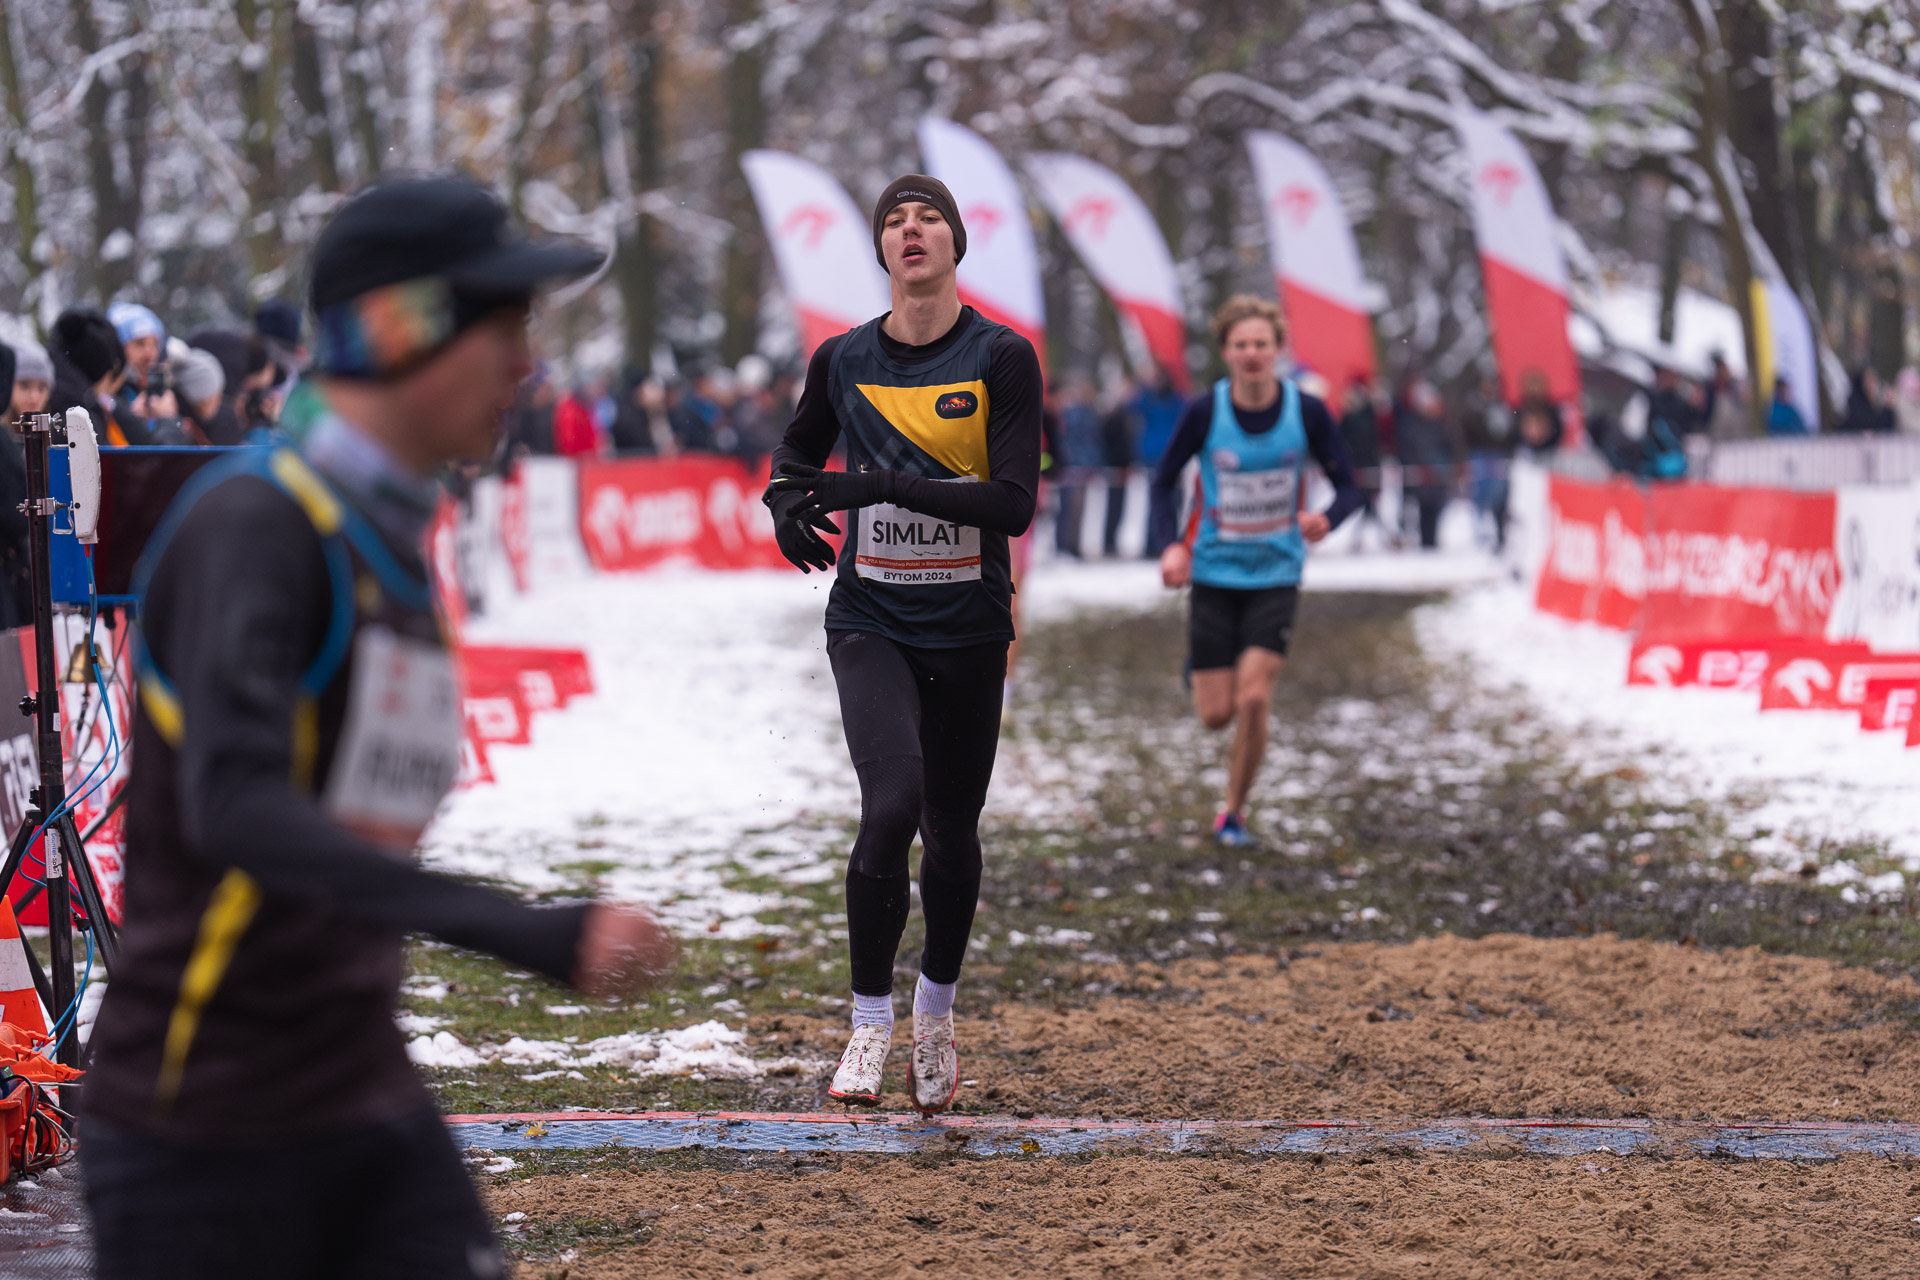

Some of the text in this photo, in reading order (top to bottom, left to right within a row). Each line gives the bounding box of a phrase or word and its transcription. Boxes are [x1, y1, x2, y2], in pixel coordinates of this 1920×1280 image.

[872, 520, 960, 545] SIMLAT
[884, 571, 952, 581] BYTOM 2024
